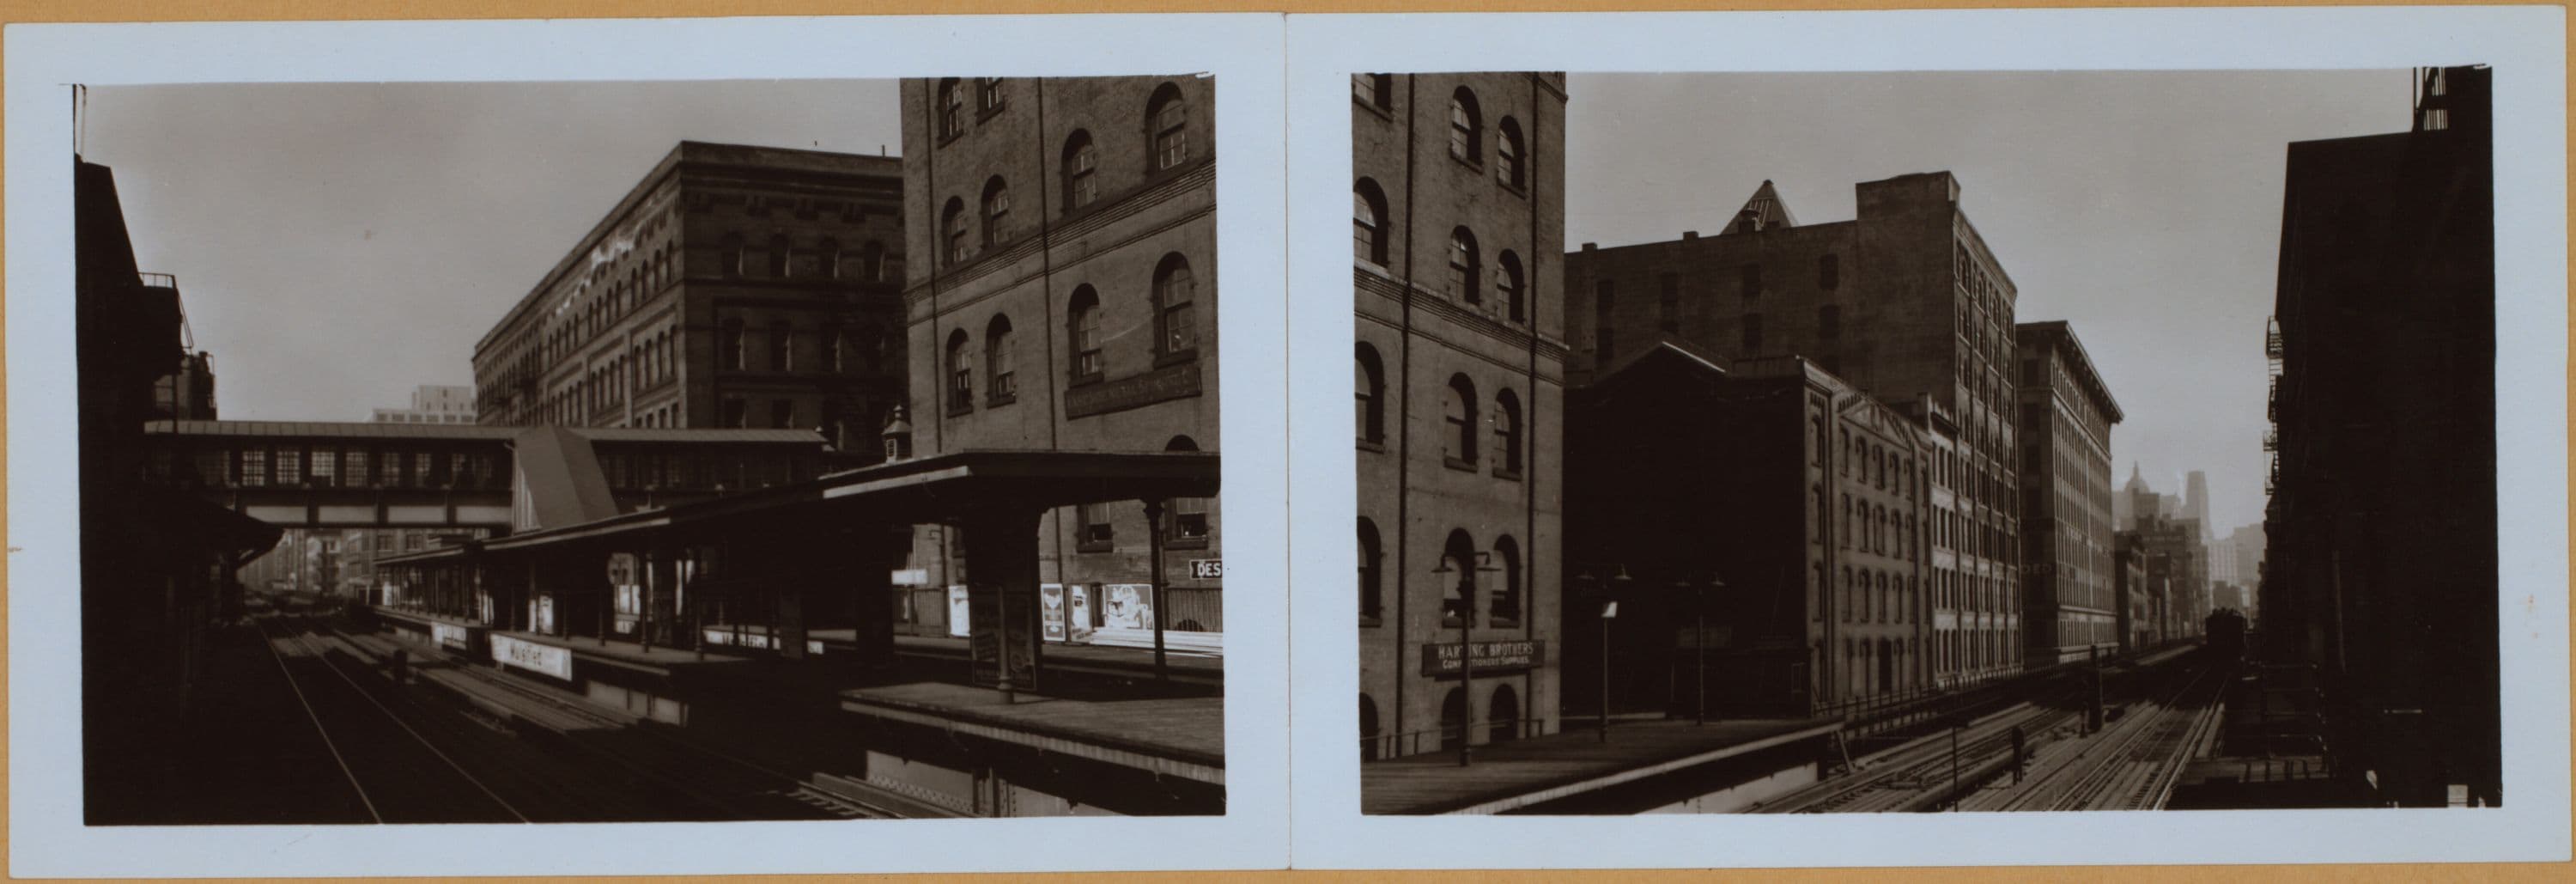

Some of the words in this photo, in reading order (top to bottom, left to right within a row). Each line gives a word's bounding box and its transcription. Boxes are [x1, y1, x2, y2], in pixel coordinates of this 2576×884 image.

[1197, 563, 1221, 576] DES
[1438, 644, 1485, 659] HARNG
[1443, 658, 1499, 669] CONFTIONERS
